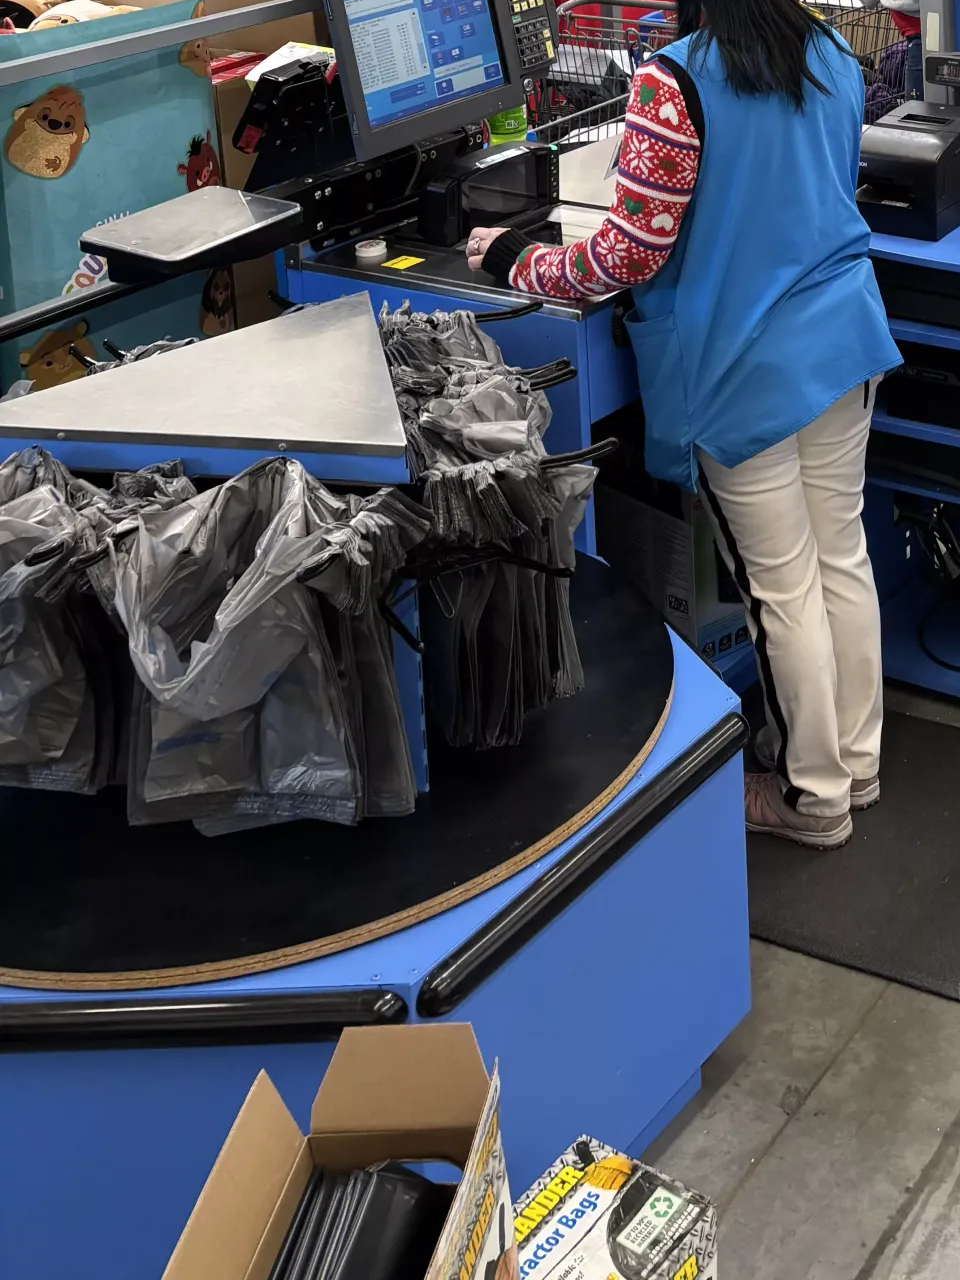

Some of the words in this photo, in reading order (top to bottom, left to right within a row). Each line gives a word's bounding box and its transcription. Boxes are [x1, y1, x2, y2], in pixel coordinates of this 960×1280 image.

[515, 1166, 584, 1244] ANDER
[556, 1190, 600, 1231] Bags
[458, 1183, 494, 1280] ANDER
[624, 1232, 632, 1240] UP
[630, 1226, 638, 1235] TO
[630, 1220, 653, 1244] RECYCLED
[636, 1224, 659, 1248] MATERIAL
